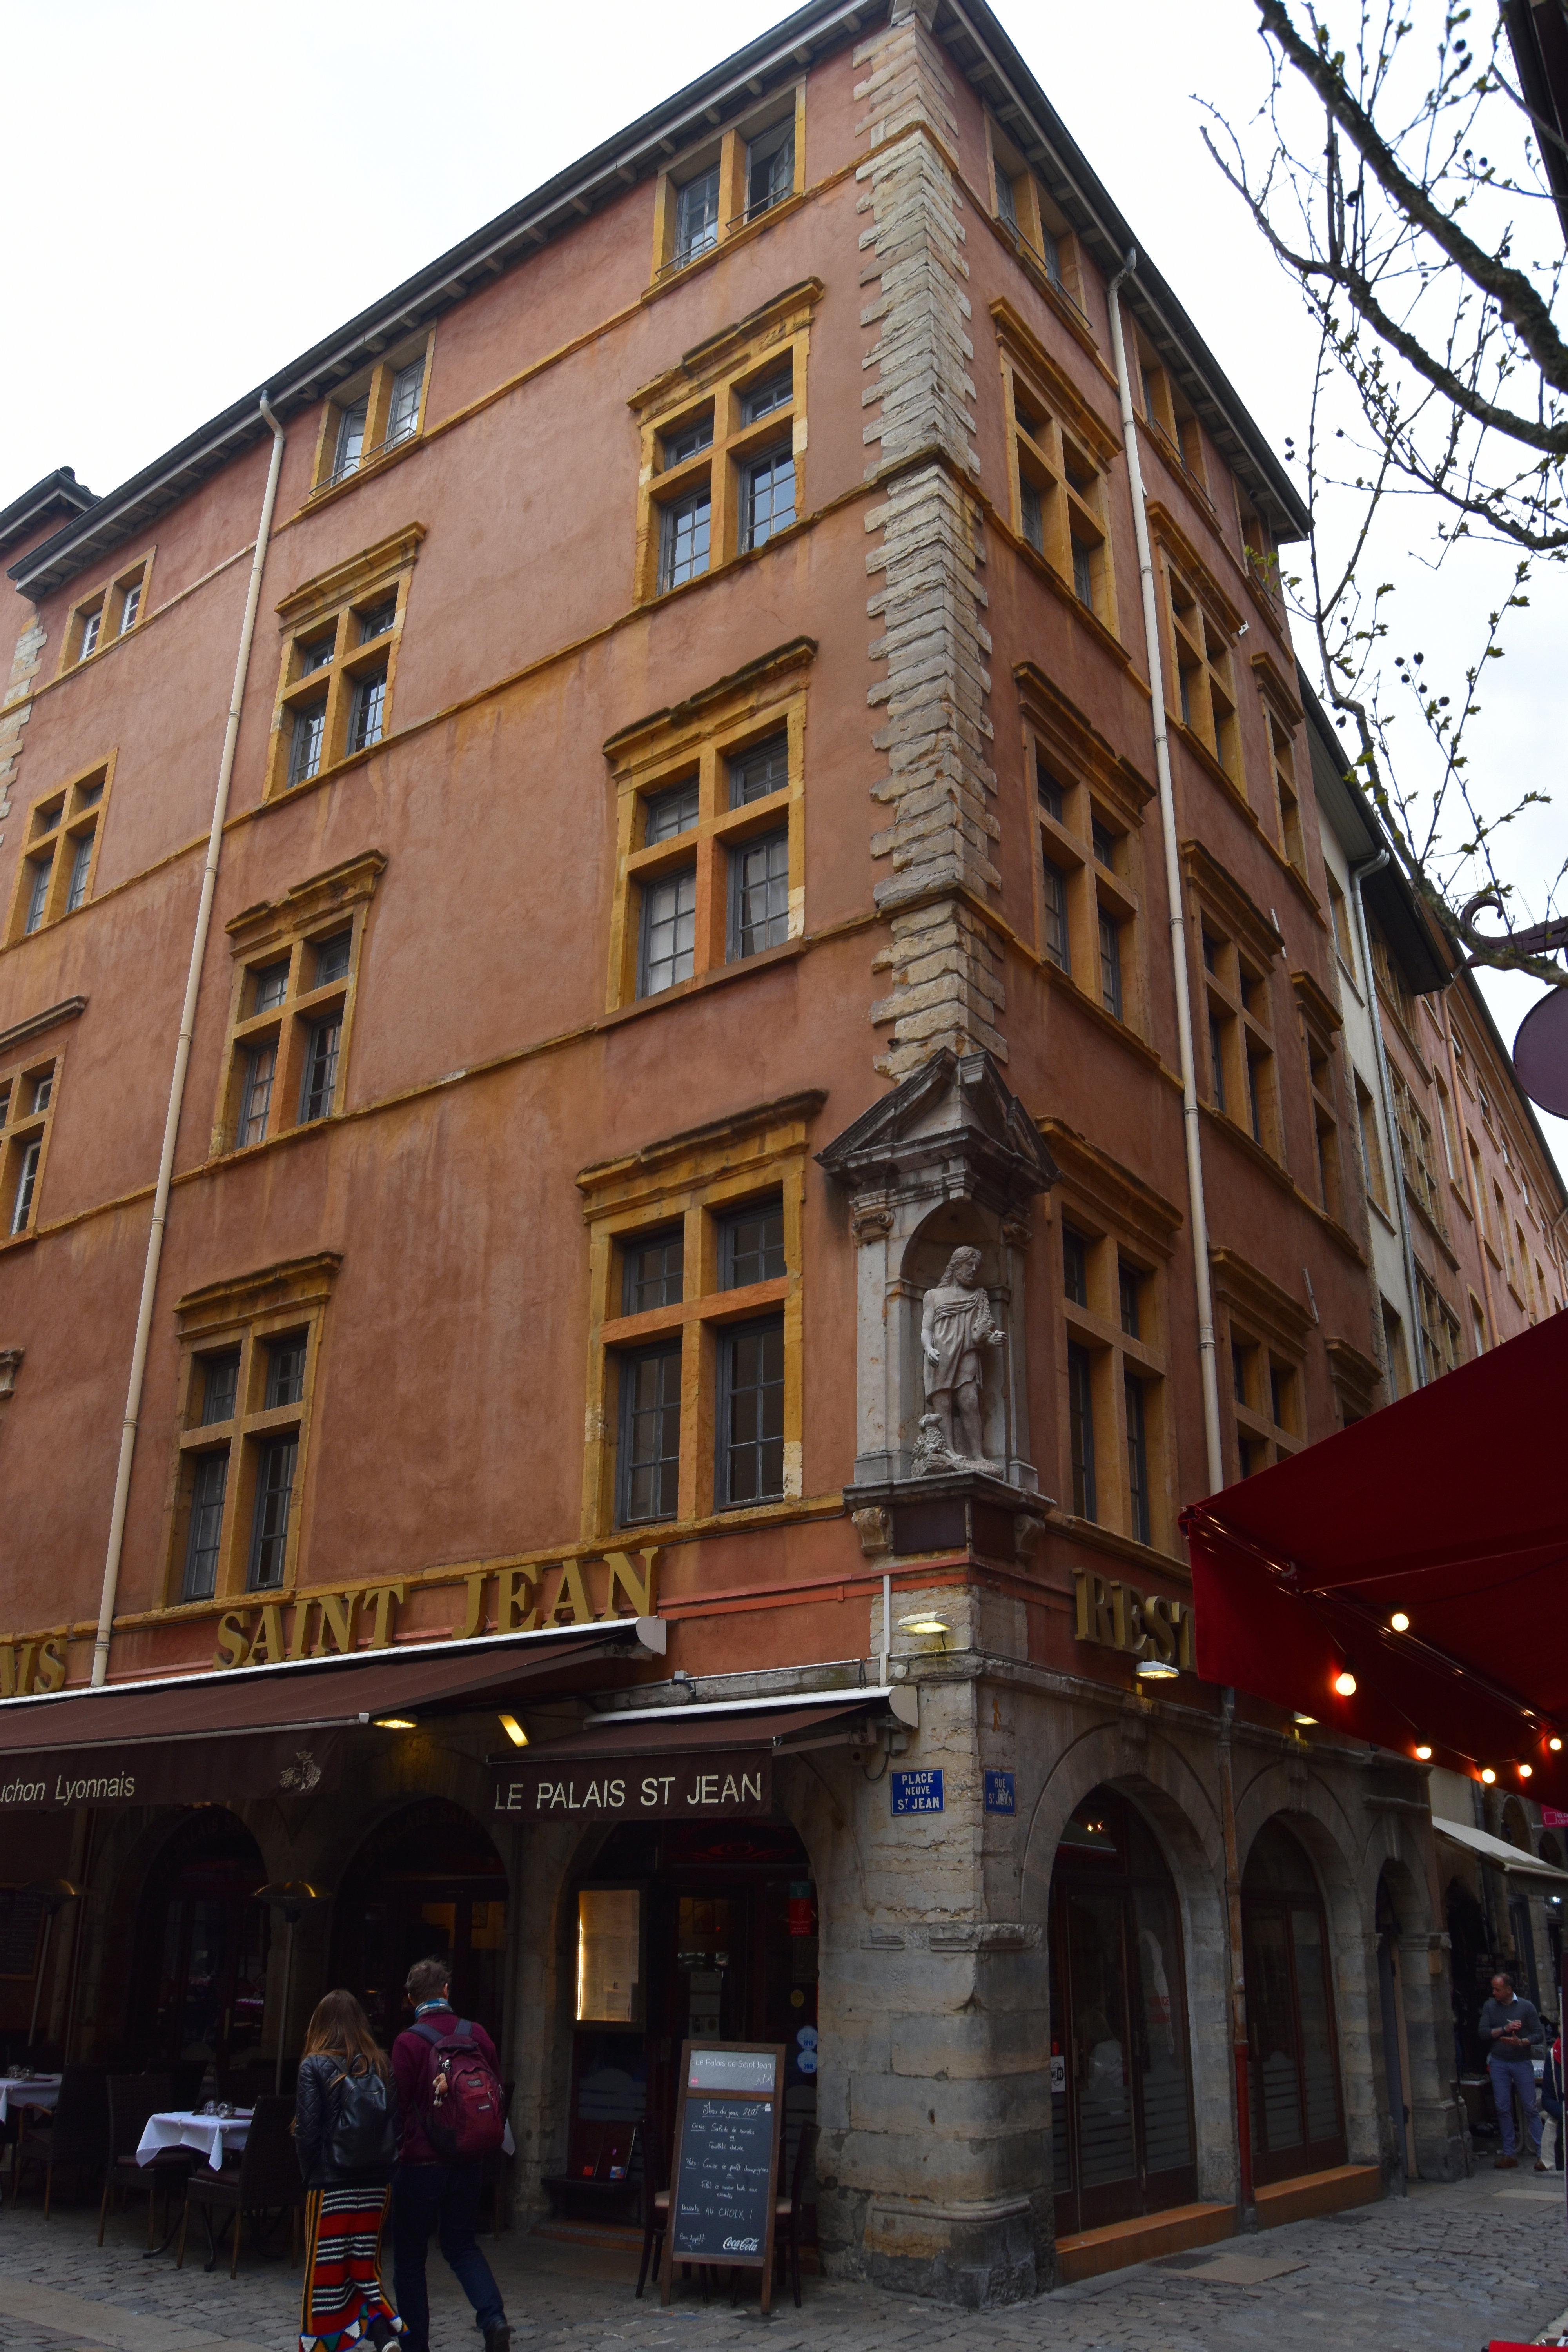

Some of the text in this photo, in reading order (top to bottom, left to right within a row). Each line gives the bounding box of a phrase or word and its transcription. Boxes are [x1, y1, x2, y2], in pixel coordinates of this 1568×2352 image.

[213, 1582, 410, 1671] SAINT
[452, 1546, 664, 1639] JEAN
[902, 1773, 933, 1784] PLACE
[995, 1777, 1006, 1788] RUE
[55, 1770, 135, 1806] Lyonnais
[495, 1772, 761, 1810] LE PALAIS ST JEAN
[906, 1785, 931, 1795] NEUVE
[911, 1797, 940, 1810] JEAN
[996, 1795, 1012, 1806] JEAN
[706, 2058, 726, 2067] Palais
[738, 2060, 755, 2069] Saint
[720, 2106, 727, 2115] du
[711, 2123, 728, 2133] Salade
[703, 2158, 718, 2169] Cuisse
[705, 2207, 714, 2216] AU
[719, 2208, 744, 2221] CHOIX
